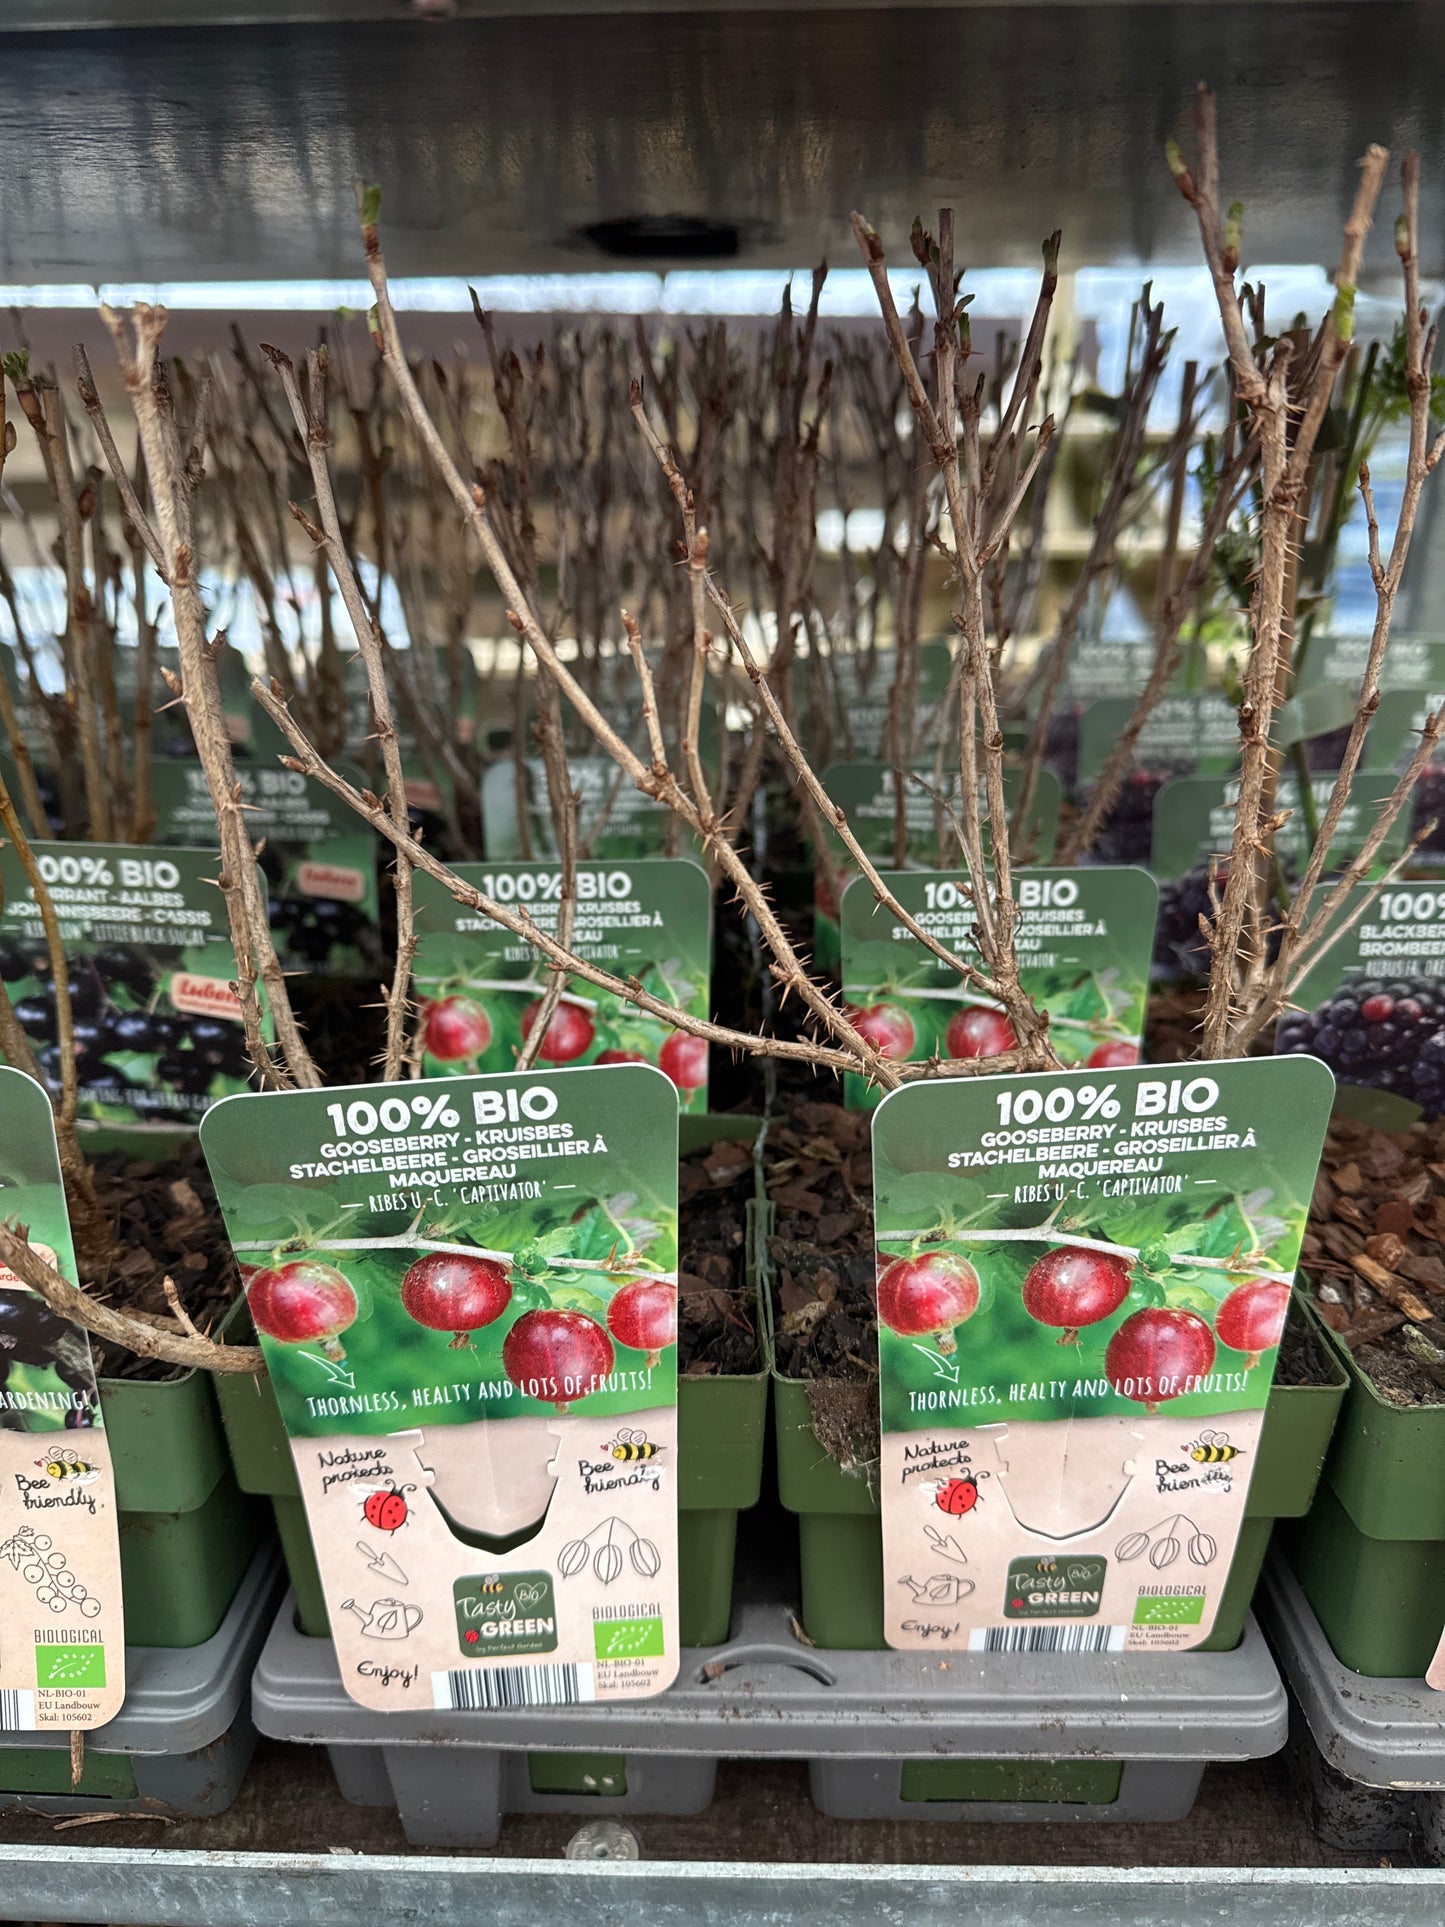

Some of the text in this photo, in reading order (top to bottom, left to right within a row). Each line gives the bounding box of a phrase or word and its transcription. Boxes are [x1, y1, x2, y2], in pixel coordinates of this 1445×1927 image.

[37, 855, 181, 889] 00% BIO
[577, 871, 632, 899] BIO
[1019, 879, 1078, 908] BIO
[5, 901, 144, 922] JOHNNISBEERE
[577, 902, 641, 914] KRUISBES
[1014, 923, 1093, 937] ROSEILLIER
[1359, 940, 1445, 956] BROMBEE
[327, 1086, 558, 1137] 100% BIO
[996, 1077, 1219, 1126] 100% BIO
[320, 1132, 460, 1160] GOOSEBERRY
[476, 1123, 574, 1146] KRUISBES
[981, 1123, 1116, 1149] GOOSEBERRY
[1131, 1116, 1228, 1137] KRUISBES
[290, 1152, 447, 1180] STACHELBEERE
[463, 1139, 592, 1165] GROSEILLIER
[592, 1133, 608, 1153] À
[948, 1142, 1098, 1168] STACHELBEERE
[1114, 1132, 1241, 1156] GROSEILLIER
[1241, 1127, 1257, 1147] À
[388, 1163, 517, 1189] MAQUEREAU
[1038, 1156, 1163, 1180] MAQUEREAU
[369, 1193, 407, 1213] RIBES
[453, 1180, 547, 1206] 'CAPTIVATOR'
[1014, 1183, 1050, 1204] RIBES
[1096, 1174, 1189, 1198] 'CAPTIVATOR'
[307, 1370, 653, 1417] THORNLESS, HEALTY AND LOTS OF FRUITS!
[909, 1370, 1248, 1412] THORNLESS, HEALTY AND LOTS OF FRUITS!
[318, 1448, 387, 1468] Nature
[904, 1440, 970, 1460] Nature
[578, 1460, 614, 1477] Bee
[901, 1451, 972, 1484] protects
[1156, 1459, 1190, 1476] Bee
[15, 1474, 50, 1491] Bee
[23, 1486, 96, 1514] friendly
[1009, 1573, 1066, 1593] Tasty
[1138, 1585, 1207, 1596] BIOLOGICAL
[519, 1589, 540, 1601] BIO
[1027, 1590, 1099, 1606] GREEN
[457, 1596, 516, 1621] Tasty
[592, 1603, 663, 1620] BIOLOGICAL
[34, 1629, 104, 1643] BIOLOGICAL
[480, 1617, 555, 1637] GREEN
[900, 1619, 960, 1639] Enjoy!
[597, 1658, 645, 1668] NL-BIO-01
[357, 1660, 419, 1688] Enjoy!
[597, 1668, 660, 1679] EU Landbouw
[38, 1689, 87, 1698] NL-BIO-01
[598, 1679, 651, 1689] Skal: 105602
[38, 1701, 101, 1710] EU Landbouw
[38, 1713, 92, 1722] Skal: 105602
